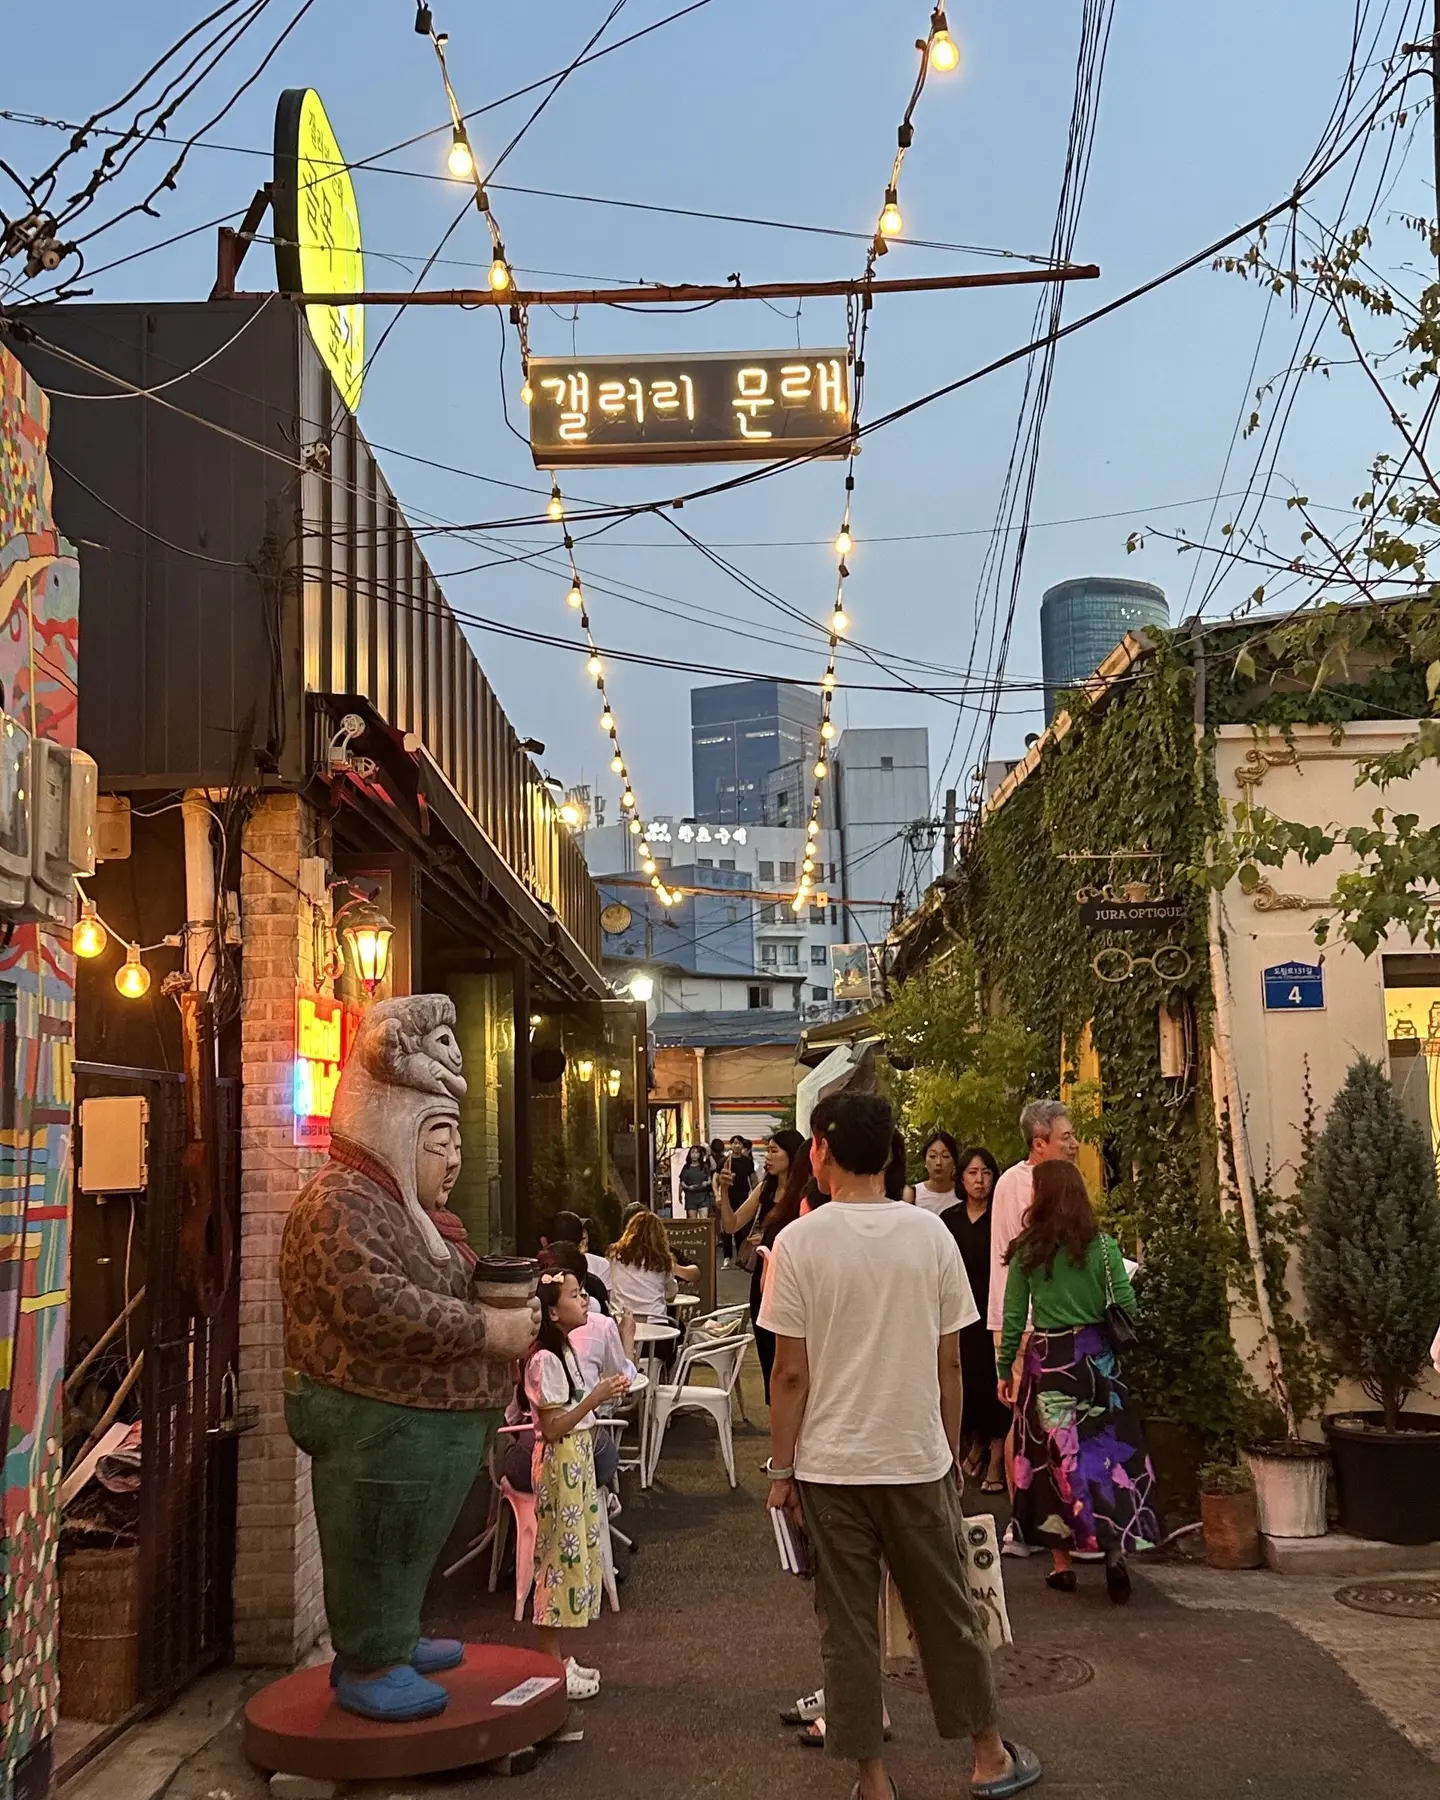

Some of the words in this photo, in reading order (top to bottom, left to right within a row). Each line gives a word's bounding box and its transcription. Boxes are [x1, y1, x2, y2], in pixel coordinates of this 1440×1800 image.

[302, 151, 335, 272] 골목
[540, 371, 694, 440] 갤러리
[731, 359, 841, 440] 문래
[1095, 909, 1127, 921] JURA
[1128, 906, 1183, 919] OPTIQUE
[1288, 985, 1302, 1004] 4
